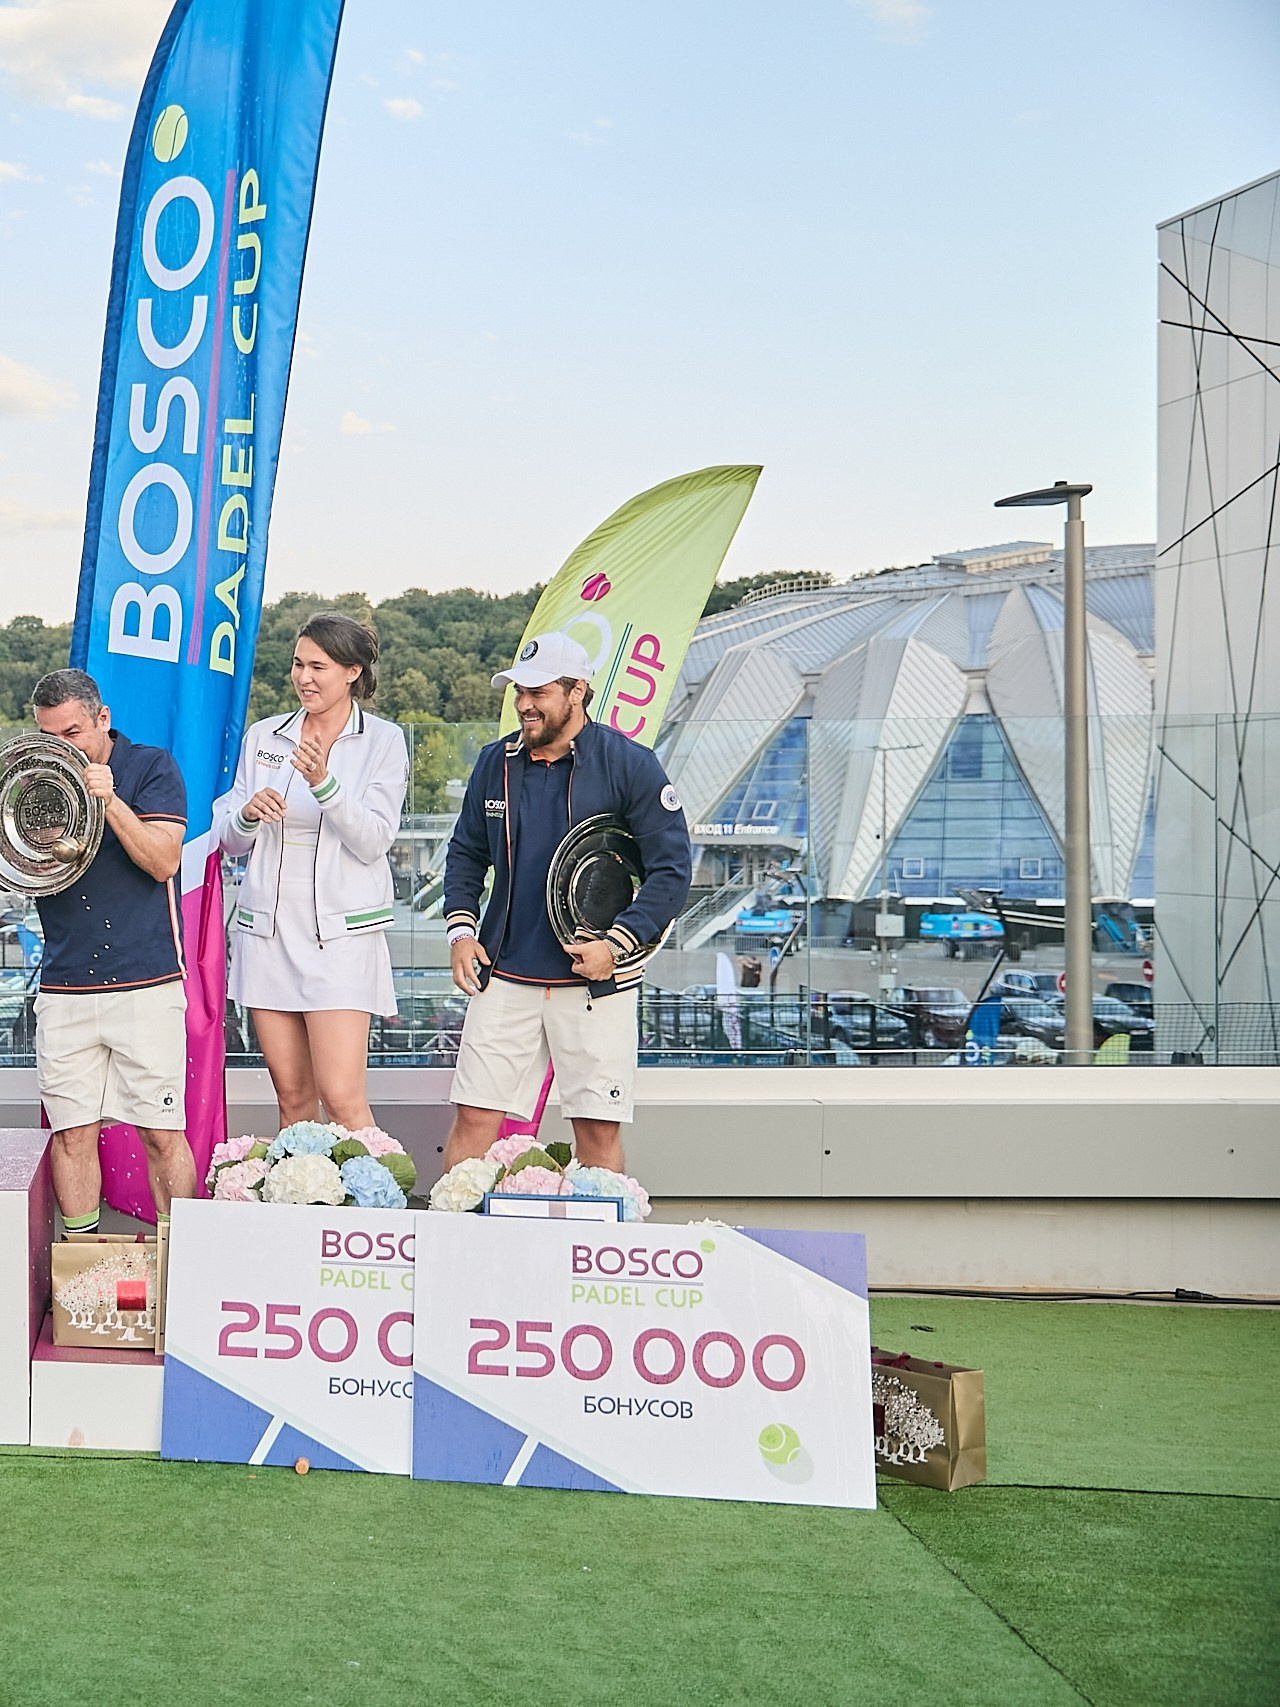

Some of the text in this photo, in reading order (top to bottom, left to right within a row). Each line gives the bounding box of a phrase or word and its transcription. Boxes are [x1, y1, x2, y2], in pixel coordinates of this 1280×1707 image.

[108, 175, 214, 663] BOSCO
[209, 167, 268, 676] PADEL CUP
[610, 633, 666, 740] CUP
[257, 749, 285, 763] BOSCO
[25, 803, 62, 818] BOSCO
[694, 823, 779, 835] ВХОД 11 Entrance
[321, 1229, 415, 1262] BOSC
[572, 1244, 704, 1279] BOSCO
[320, 1267, 391, 1290] PADEL
[571, 1284, 704, 1309] PADEL CUP
[218, 1300, 359, 1363] 250
[467, 1318, 613, 1381] 250
[632, 1328, 807, 1392] 000
[584, 1396, 694, 1419] БОНУСОВ
